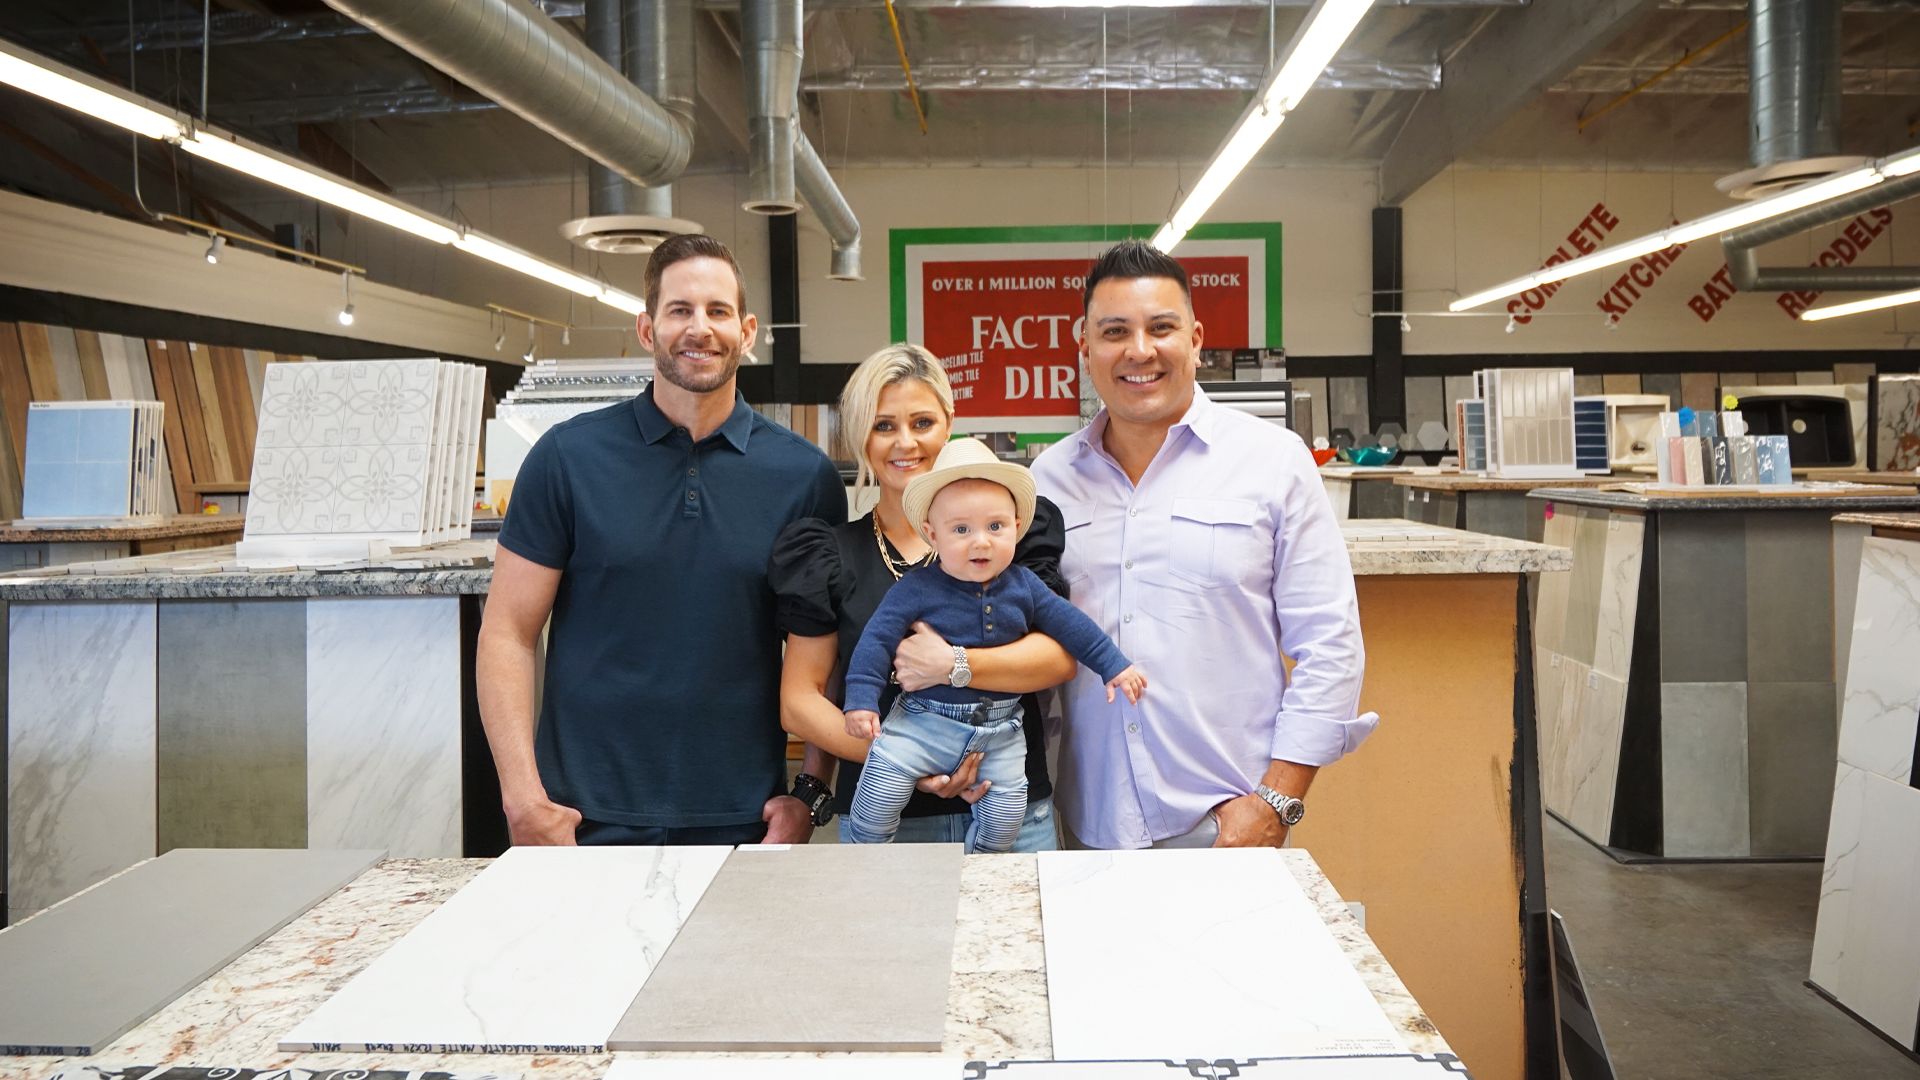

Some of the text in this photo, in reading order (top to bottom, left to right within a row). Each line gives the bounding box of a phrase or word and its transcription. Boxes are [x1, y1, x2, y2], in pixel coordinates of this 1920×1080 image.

[1596, 219, 1688, 323] KITCHE
[1776, 207, 1893, 320] REODELS
[932, 278, 973, 291] OVER
[978, 278, 984, 291] 1
[989, 277, 1056, 290] MILLION
[1191, 273, 1240, 287] STOCK
[1688, 263, 1738, 323] BAT
[970, 350, 984, 365] TILE
[965, 368, 980, 381] TILE
[440, 1044, 475, 1053] MATTE
